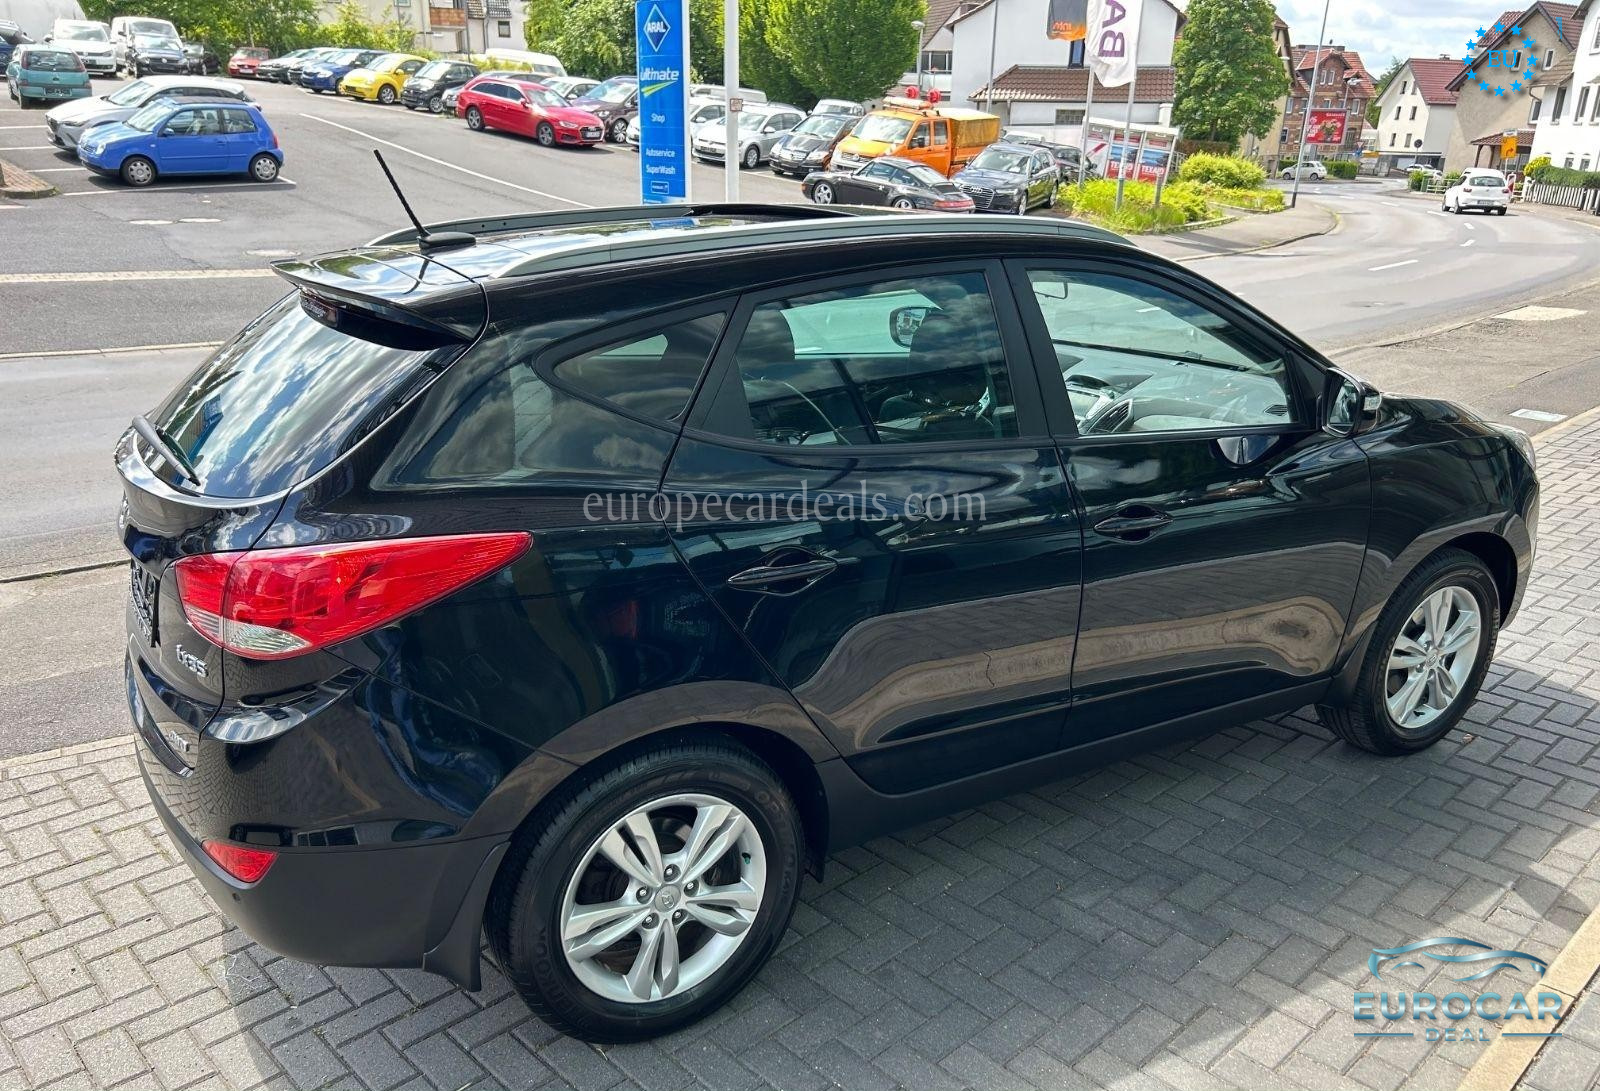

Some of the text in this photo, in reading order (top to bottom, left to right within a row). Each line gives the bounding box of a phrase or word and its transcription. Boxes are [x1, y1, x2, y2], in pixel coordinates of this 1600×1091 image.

[647, 21, 666, 33] ARAL
[640, 66, 680, 81] ultimate
[651, 113, 666, 124] Shop
[645, 147, 676, 158] Autoservice
[645, 163, 676, 175] SuperWash
